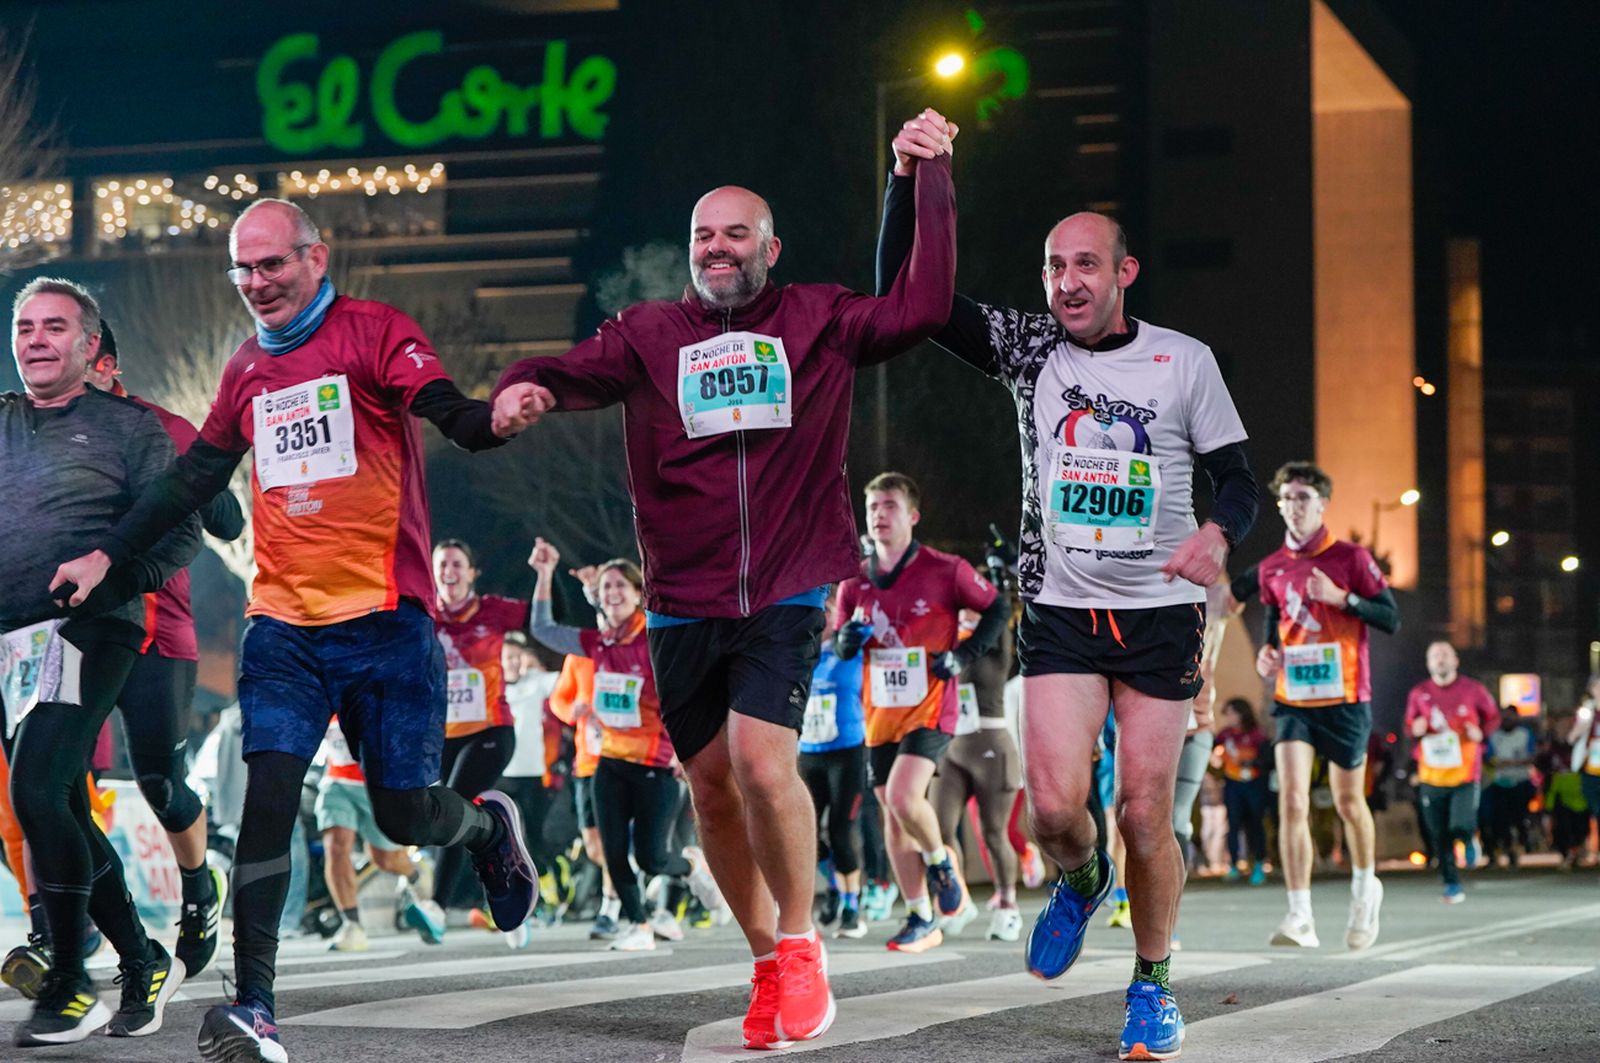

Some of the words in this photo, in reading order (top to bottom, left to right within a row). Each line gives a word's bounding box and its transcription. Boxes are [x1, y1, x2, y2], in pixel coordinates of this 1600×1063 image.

[257, 33, 363, 153] El
[371, 30, 617, 147] Corte
[702, 345, 730, 360] NOCHE
[733, 343, 745, 351] DE
[690, 361, 710, 373] SAN
[712, 352, 747, 368] ANTÓN
[700, 364, 769, 400] 8057
[265, 413, 284, 427] SAN
[275, 414, 332, 455] 3351
[1073, 459, 1106, 471] NOCHE
[1107, 461, 1119, 472] DE
[1061, 469, 1081, 481] SAN
[1082, 470, 1118, 485] ANTÓN
[1060, 483, 1146, 517] 12906
